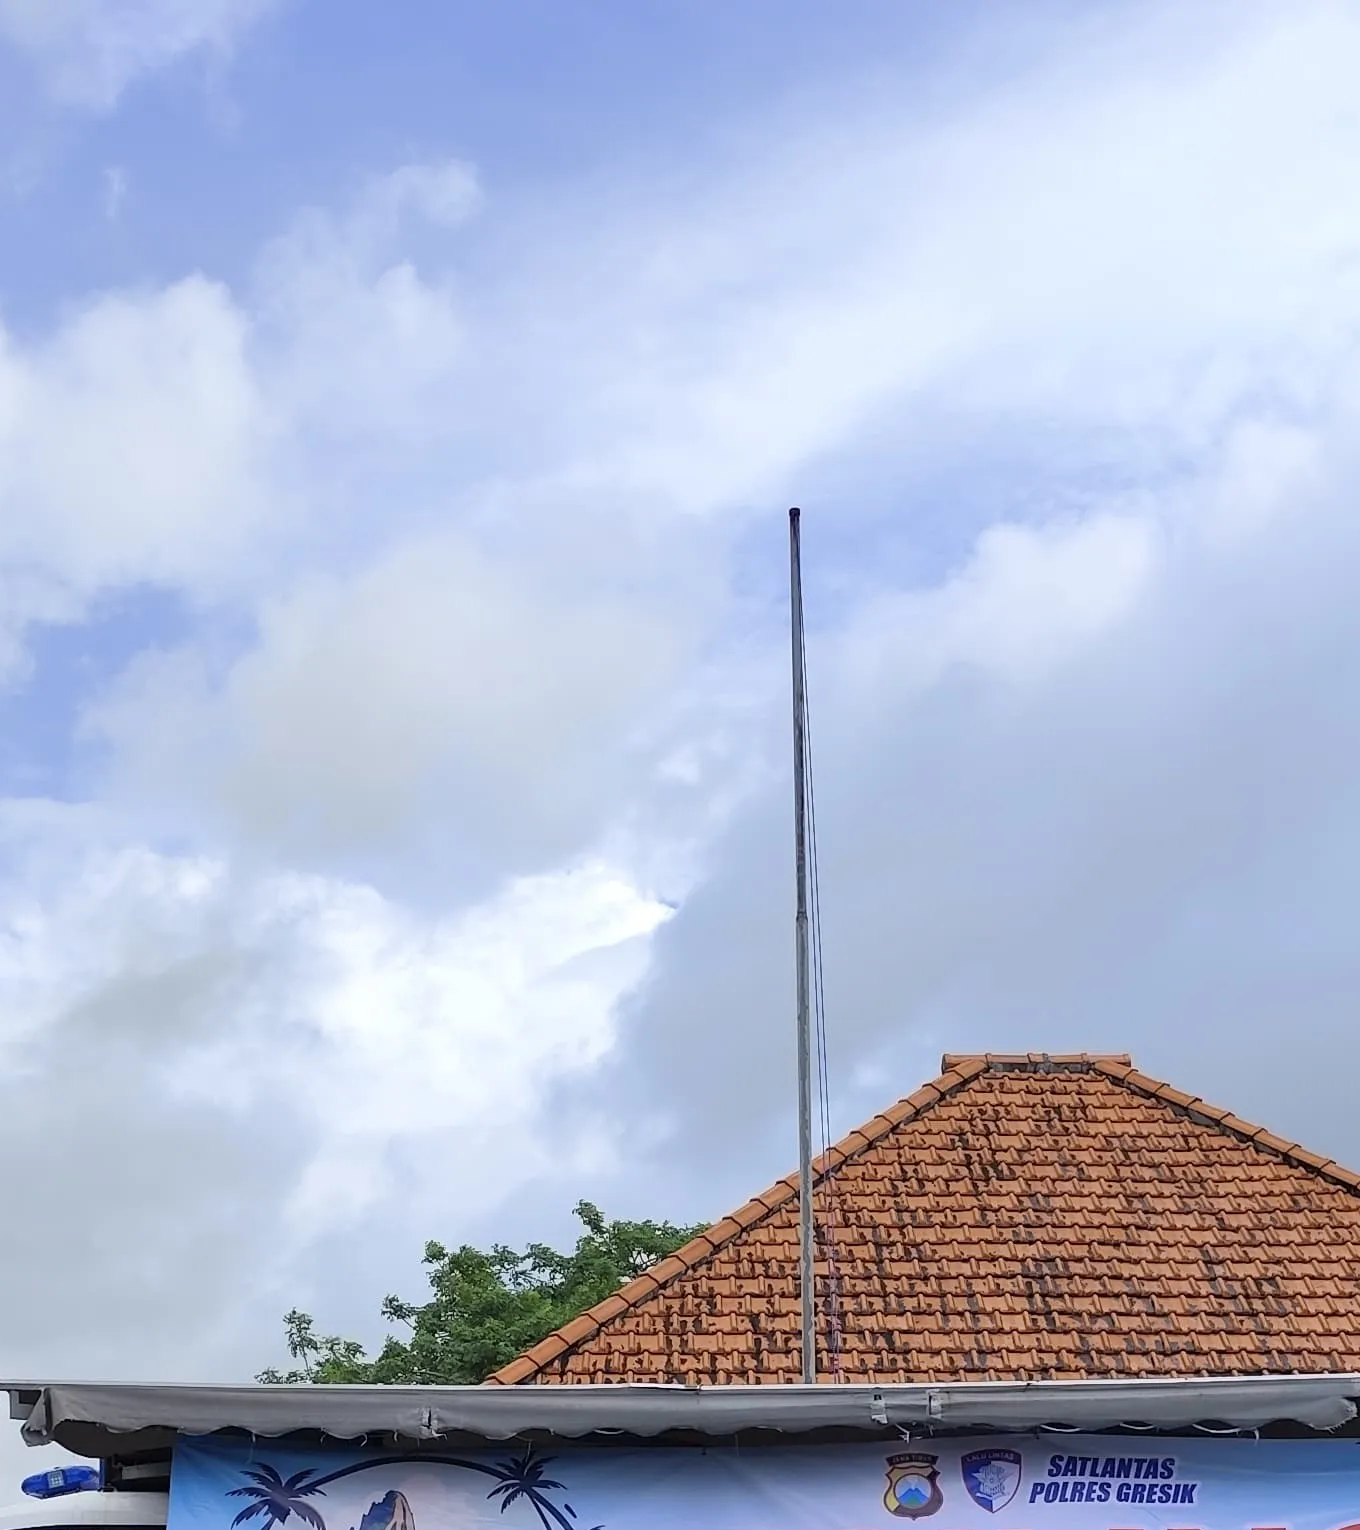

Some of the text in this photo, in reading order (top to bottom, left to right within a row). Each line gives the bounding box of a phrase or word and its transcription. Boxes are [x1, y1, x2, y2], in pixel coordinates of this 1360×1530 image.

[1048, 1455, 1175, 1480] SATLANTAS
[1029, 1482, 1198, 1505] POLRES GRESIK
